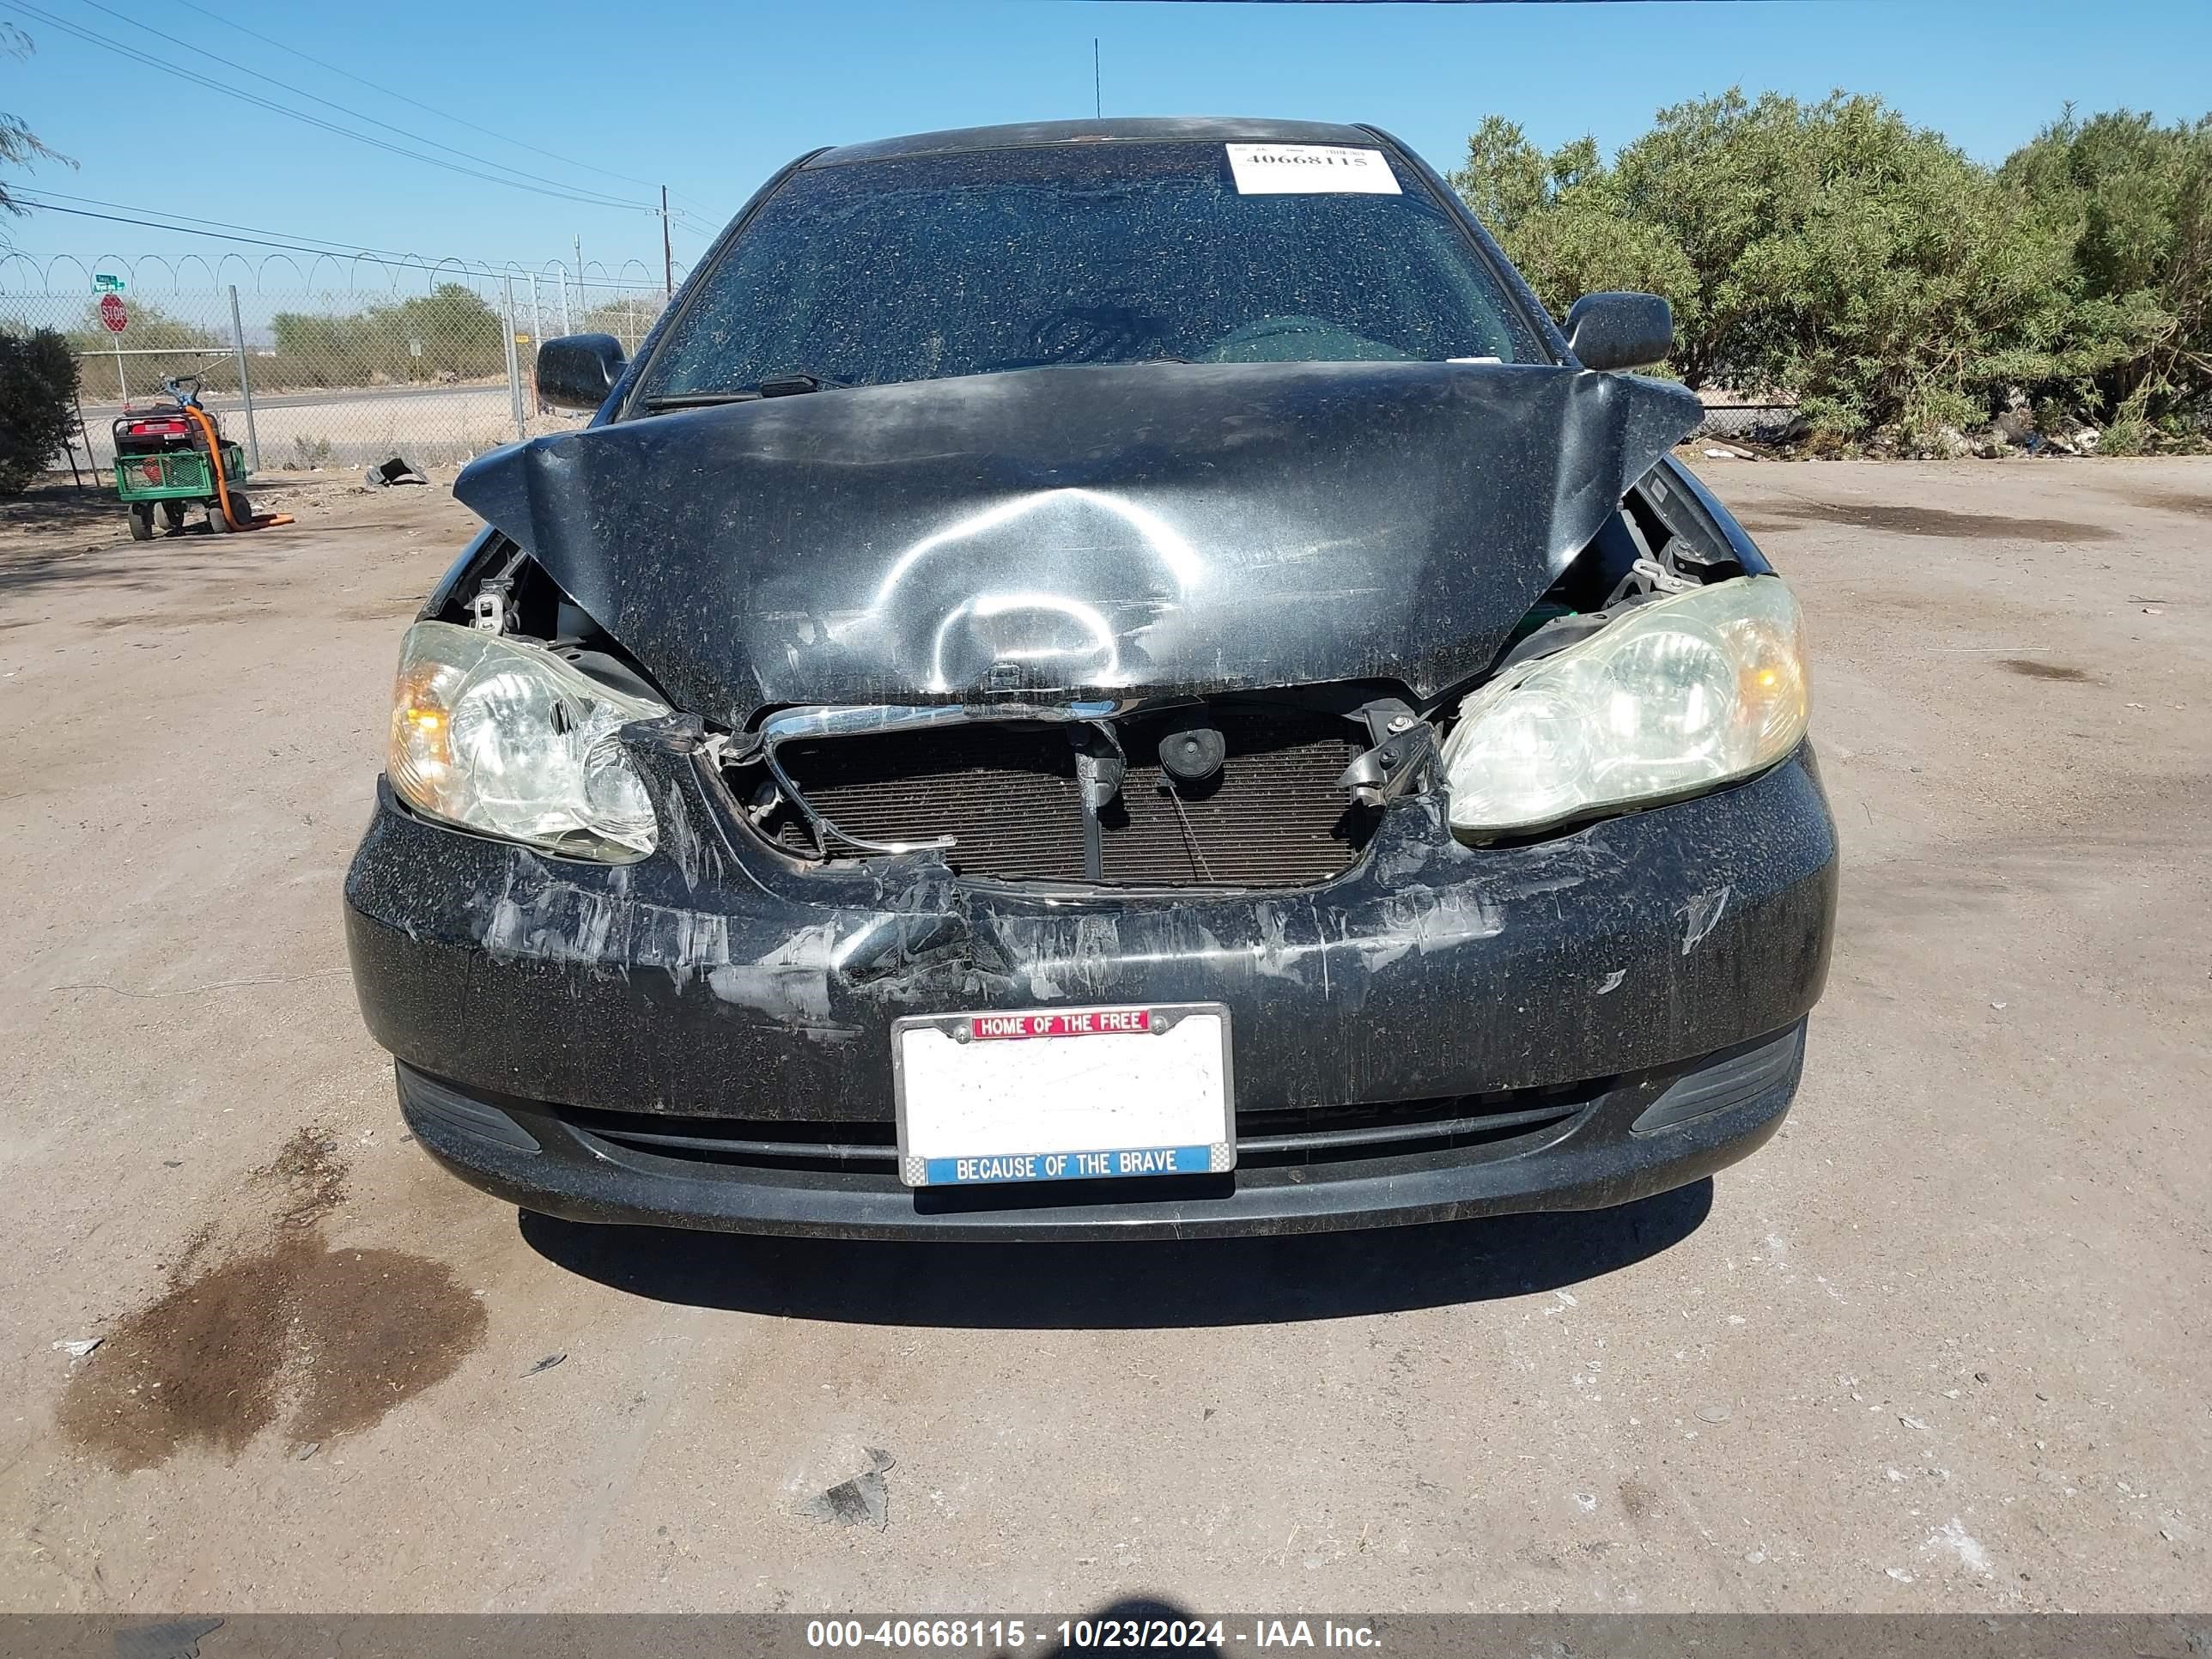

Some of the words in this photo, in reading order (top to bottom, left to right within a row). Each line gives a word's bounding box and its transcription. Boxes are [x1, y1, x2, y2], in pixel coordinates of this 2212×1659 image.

[1247, 155, 1367, 167] 40668115
[102, 305, 125, 320] STOP
[981, 1018, 1026, 1036] HOME
[1033, 1015, 1053, 1032] OF
[1063, 1013, 1092, 1031] THE
[1100, 1011, 1142, 1030] FREE
[957, 1157, 1037, 1181] BECAUSE
[1045, 1155, 1066, 1176] OF
[1076, 1152, 1110, 1174] THE
[1120, 1150, 1177, 1172] BRAVE
